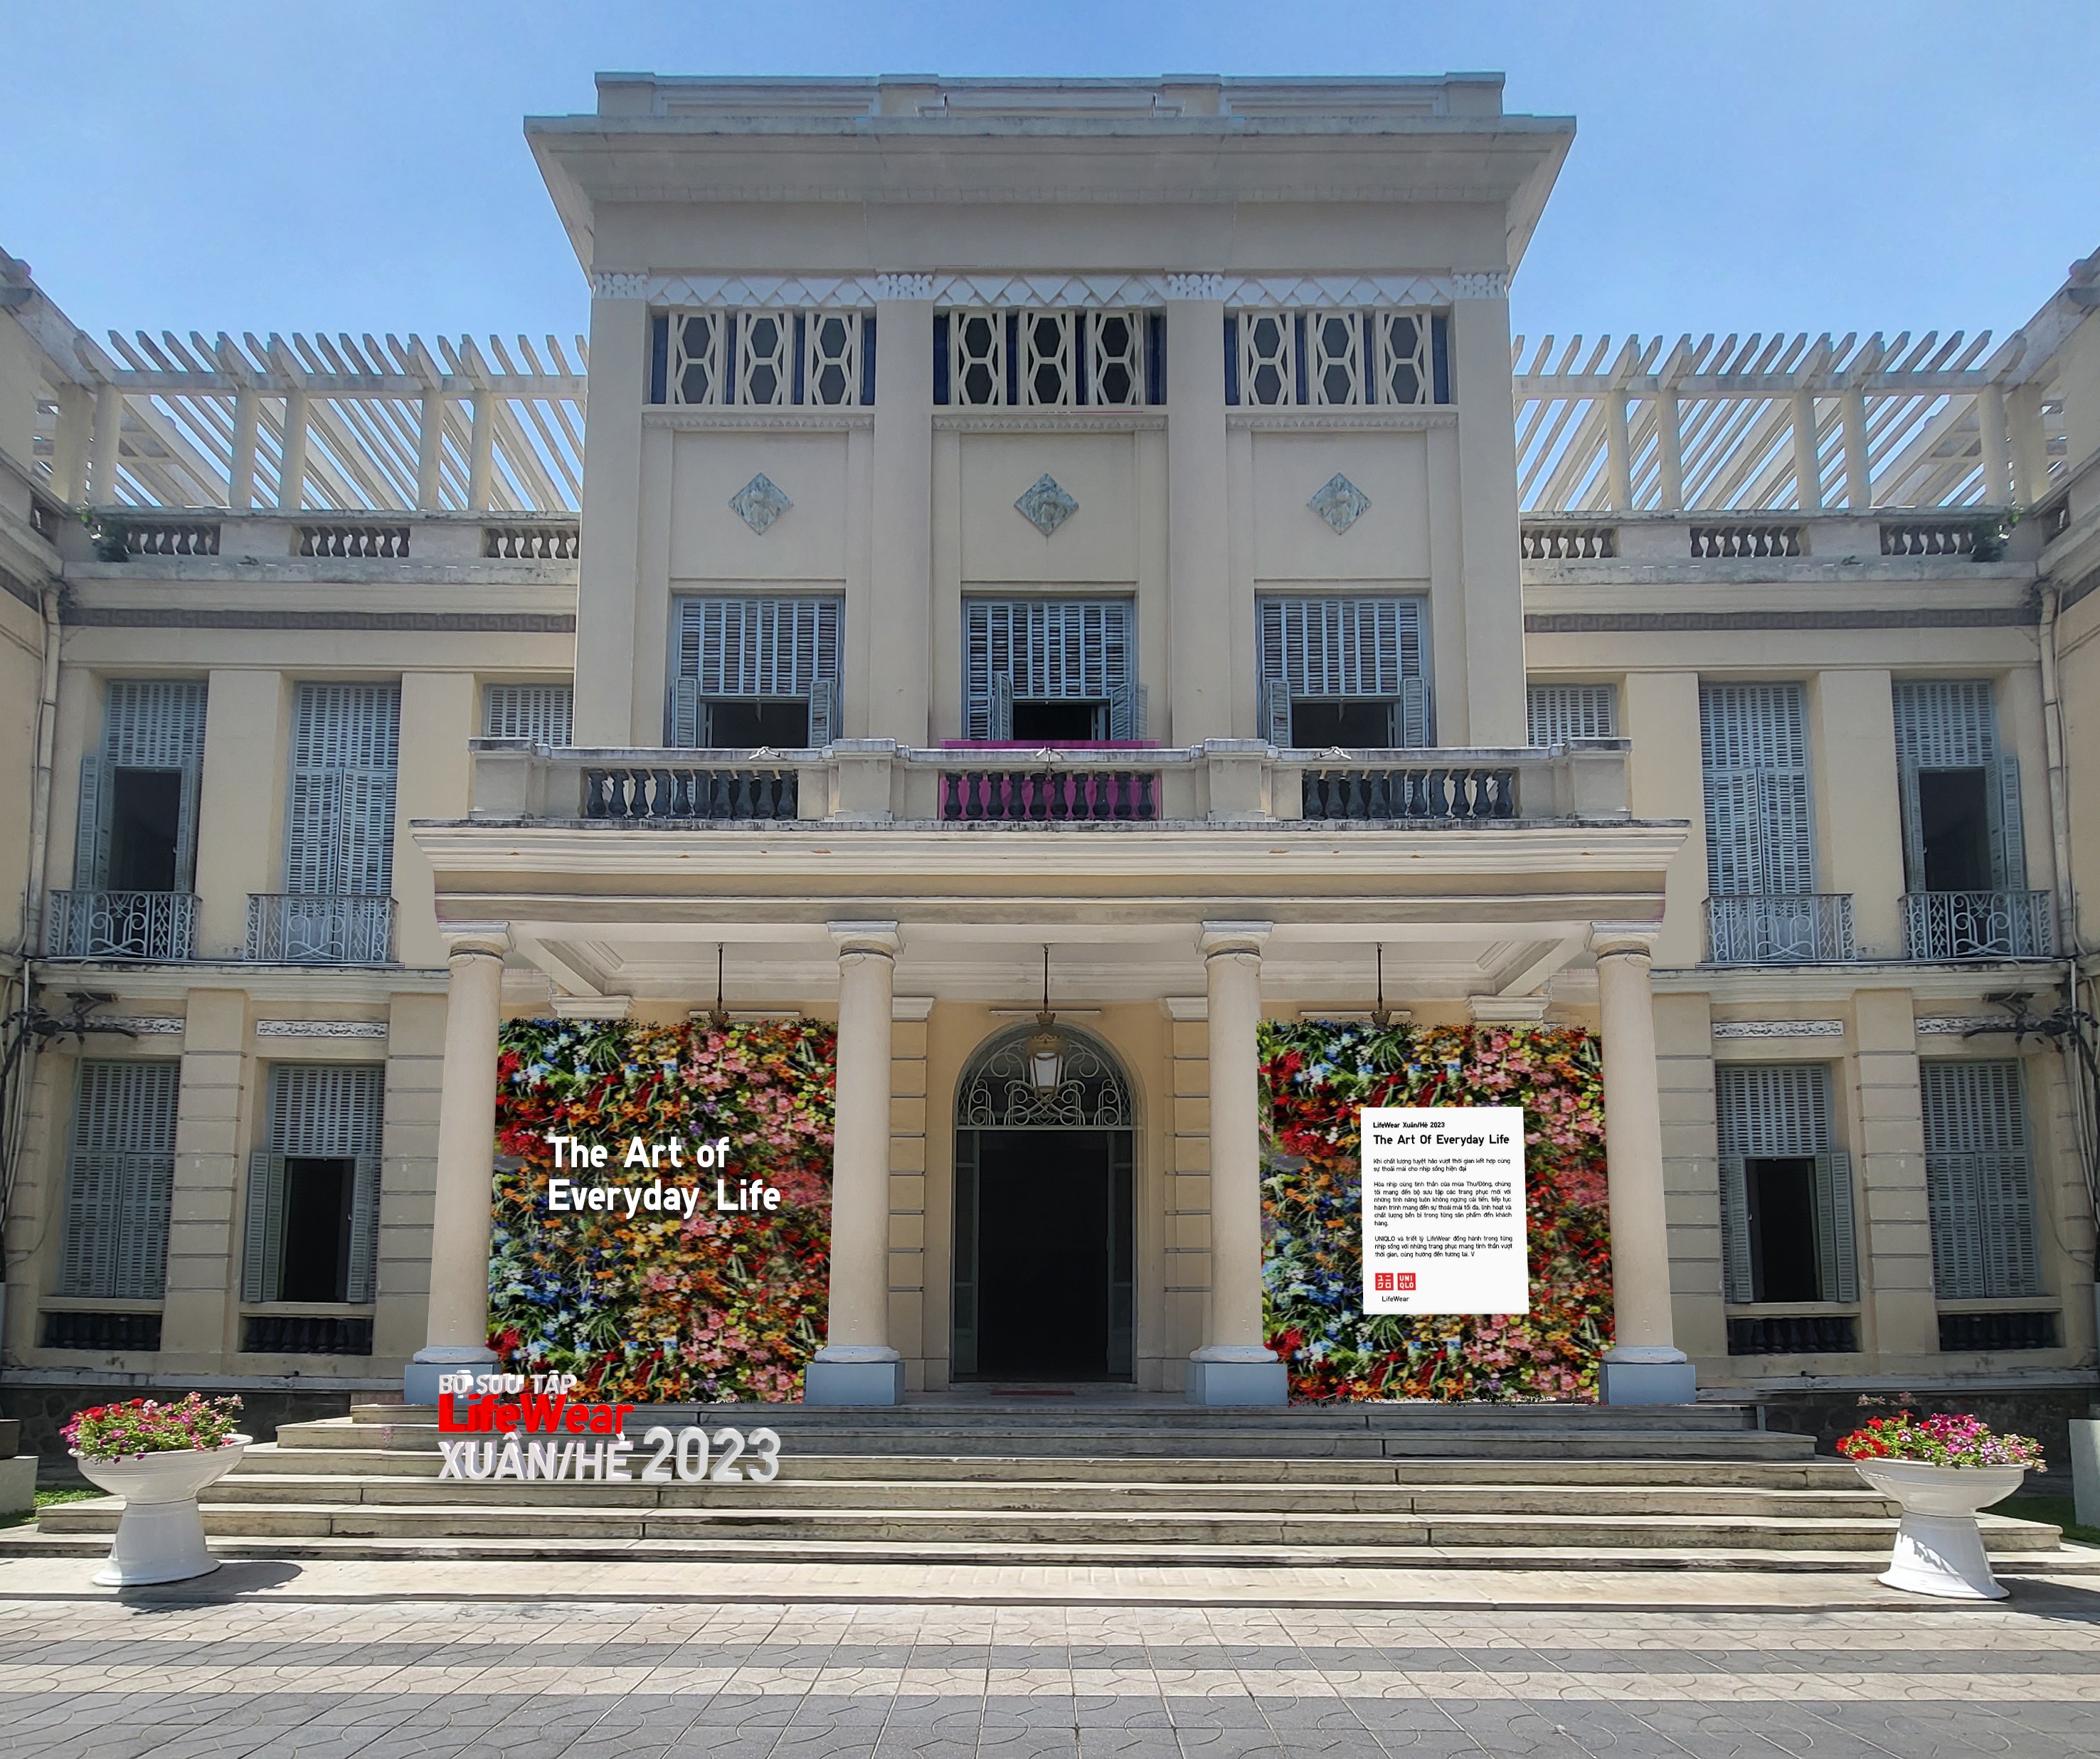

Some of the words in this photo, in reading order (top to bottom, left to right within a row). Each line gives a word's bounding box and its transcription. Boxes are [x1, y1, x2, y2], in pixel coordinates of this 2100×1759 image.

[548, 1137, 608, 1168] The
[624, 1137, 682, 1168] Art
[697, 1137, 730, 1168] of
[1373, 1134, 1393, 1144] The
[1397, 1134, 1416, 1144] Art
[1420, 1134, 1432, 1144] Of
[1436, 1134, 1485, 1147] Everyday
[1489, 1134, 1510, 1144] Life
[548, 1179, 700, 1219] Everyday
[717, 1179, 781, 1211] Life
[438, 1369, 474, 1398] BỘ
[438, 1393, 635, 1434] LifeWear
[438, 1430, 635, 1482] XUÂN/HÈ
[641, 1426, 782, 1482] 2023
